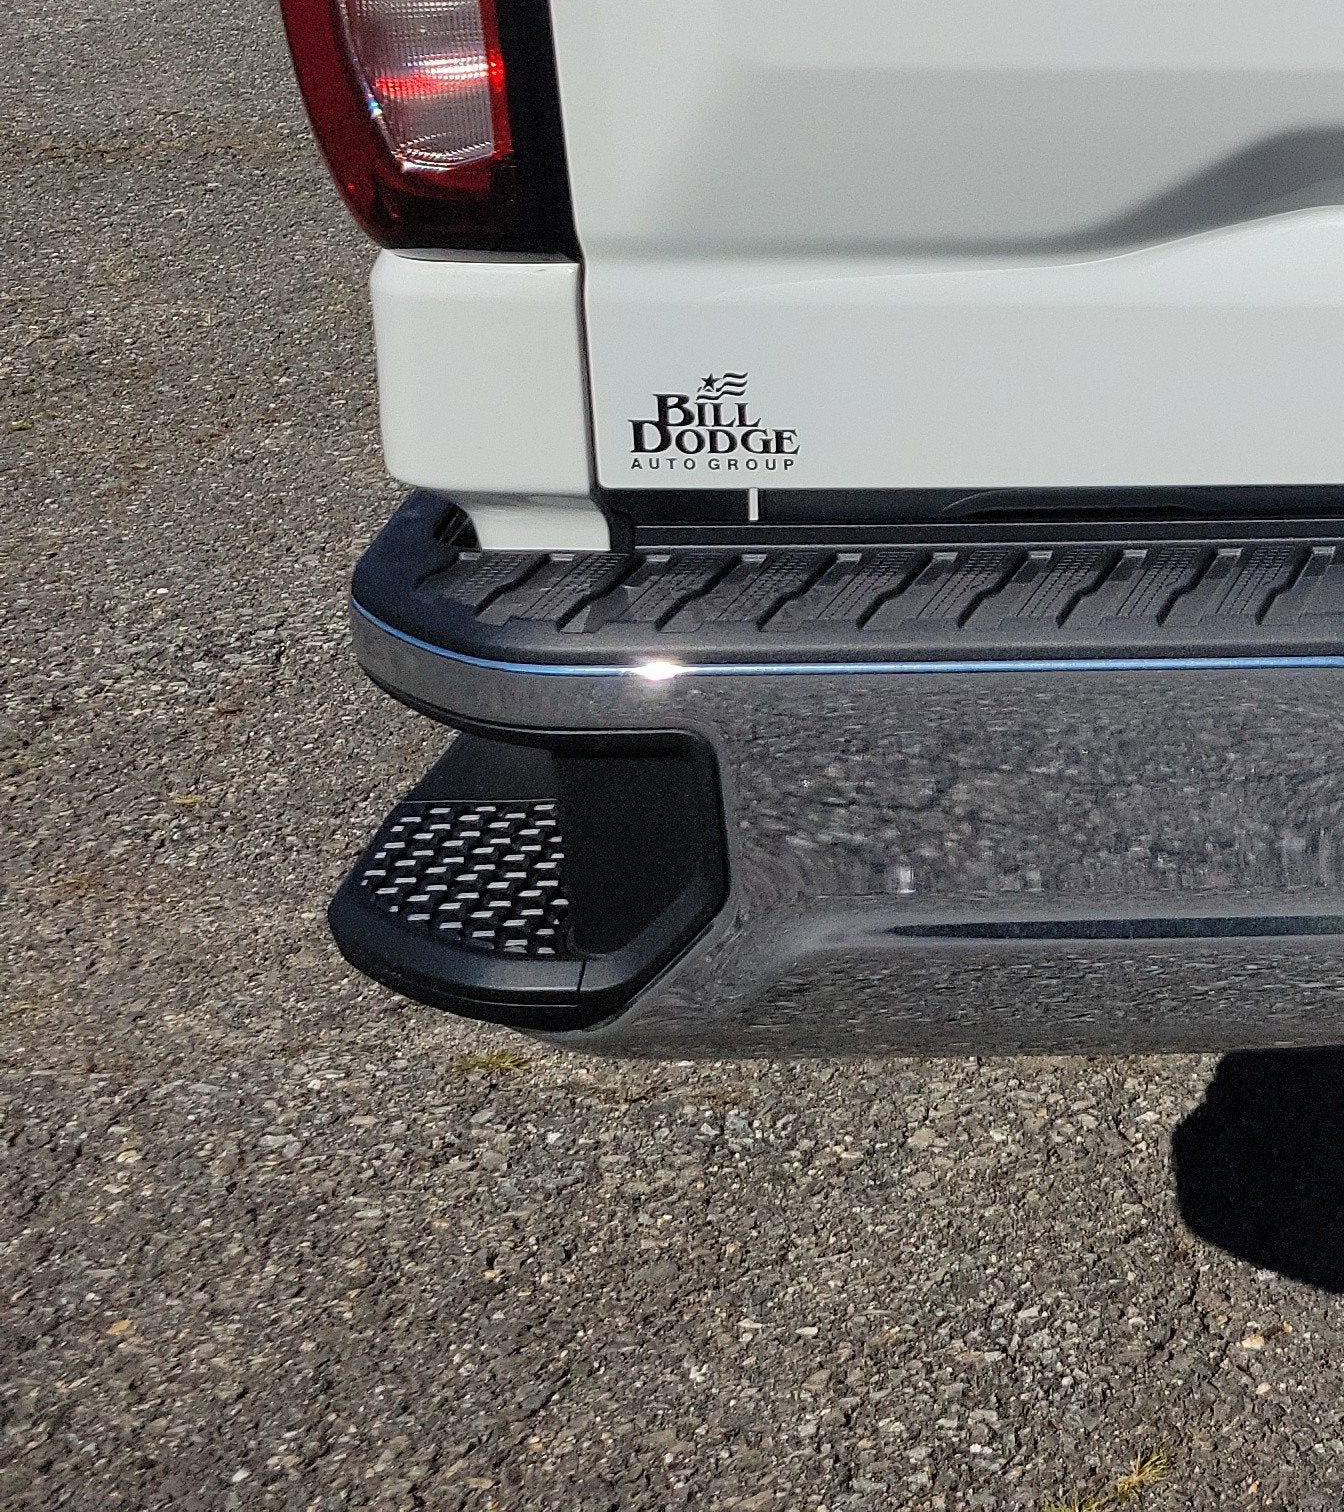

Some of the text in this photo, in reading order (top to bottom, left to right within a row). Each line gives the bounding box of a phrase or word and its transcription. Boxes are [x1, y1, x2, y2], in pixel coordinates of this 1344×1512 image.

[652, 393, 762, 428] BILL
[627, 419, 800, 455] DODGE
[630, 458, 794, 471] AUTO GROUP
